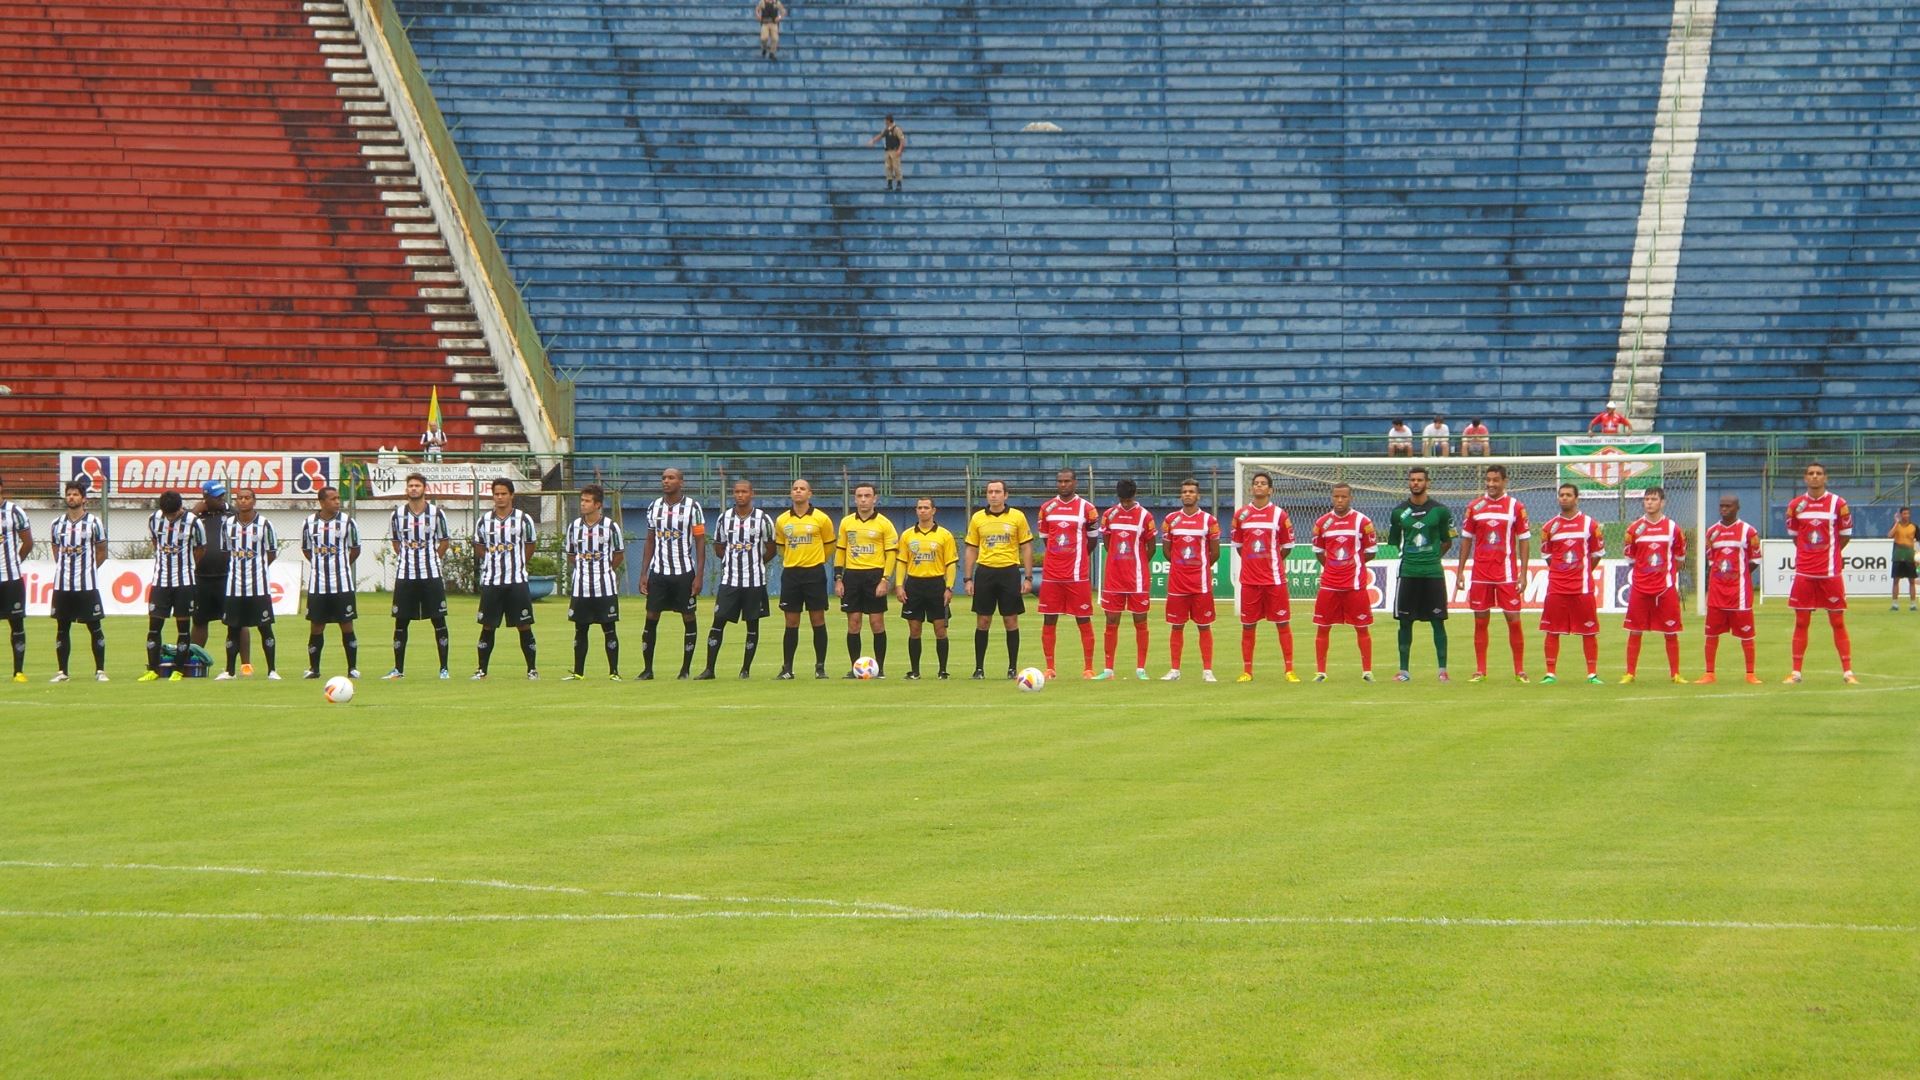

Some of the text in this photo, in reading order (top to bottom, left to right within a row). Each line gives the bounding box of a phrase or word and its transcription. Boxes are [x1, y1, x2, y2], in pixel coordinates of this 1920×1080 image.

[121, 459, 282, 489] BAHAMAS
[425, 482, 462, 493] ANTE
[1284, 559, 1318, 574] JUIZ
[1841, 556, 1887, 570] FORA
